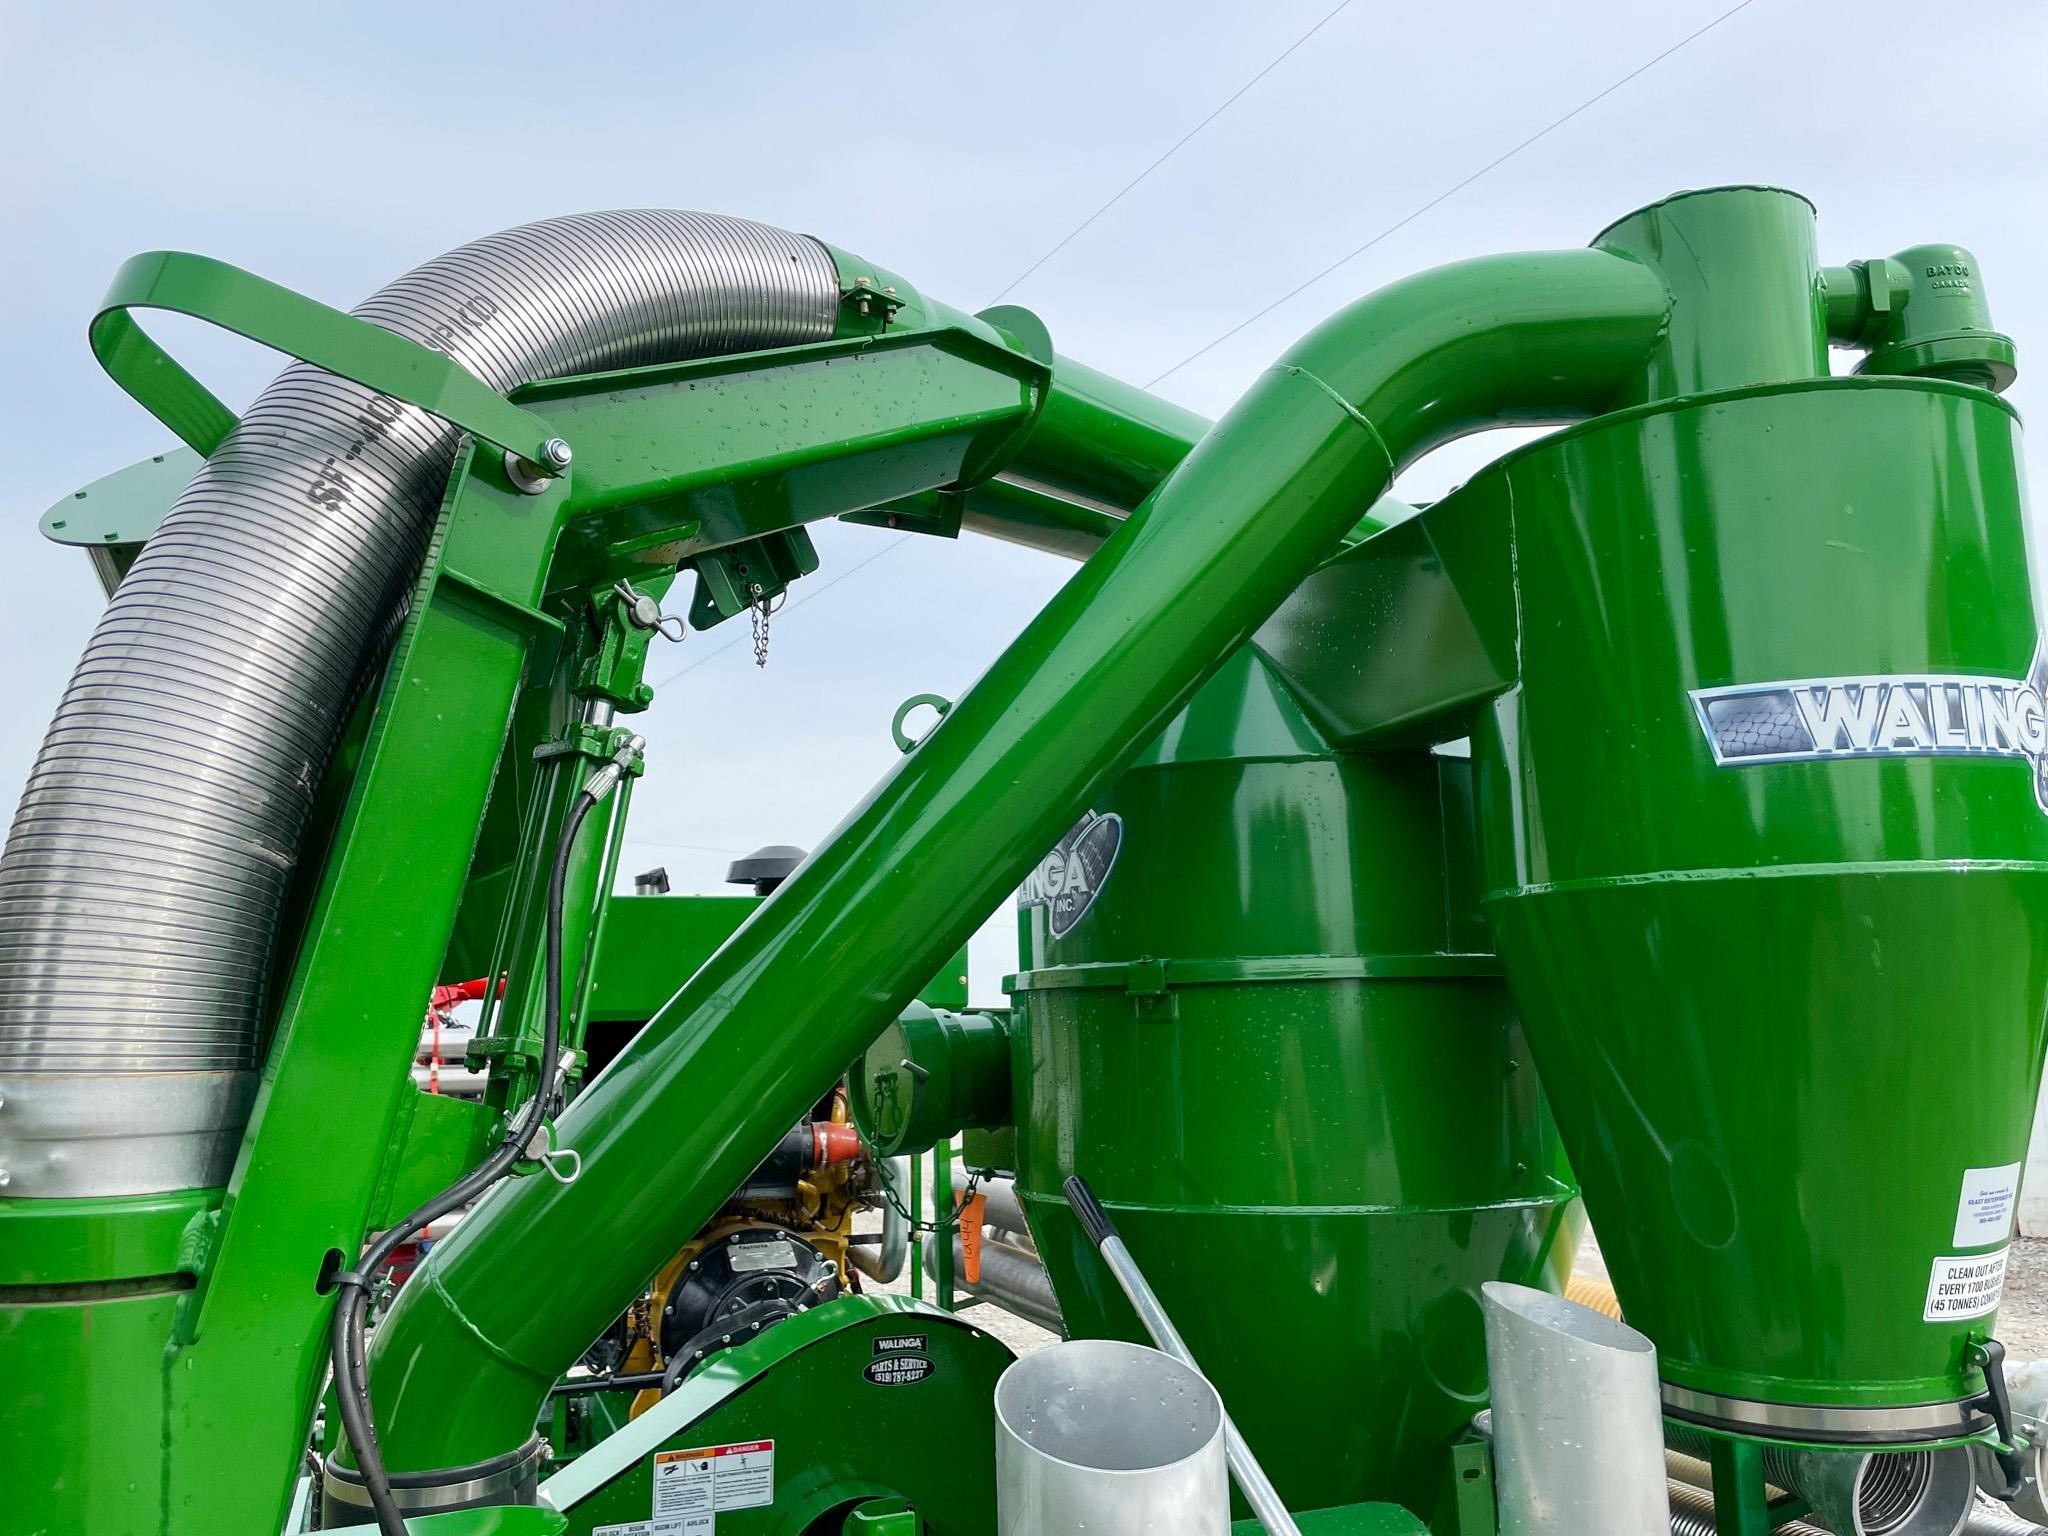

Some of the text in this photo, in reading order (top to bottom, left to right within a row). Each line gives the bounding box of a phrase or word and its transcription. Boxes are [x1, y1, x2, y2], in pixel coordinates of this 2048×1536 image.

[1794, 682, 2048, 756] WALING
[1057, 899, 1075, 912] INC.
[1948, 1267, 1974, 1279] CLEAN
[1975, 1265, 1988, 1278] OUT
[1939, 1283, 1966, 1295] EVERY
[1968, 1281, 1983, 1294] 1700
[1931, 1299, 1945, 1313] (45
[1947, 1296, 1979, 1311] TONNES)
[879, 1338, 922, 1349] WALINGA
[871, 1359, 892, 1372] PARTS
[900, 1358, 928, 1370] SERVICE
[874, 1373, 892, 1383] (519)
[733, 1444, 760, 1453] DANGER
